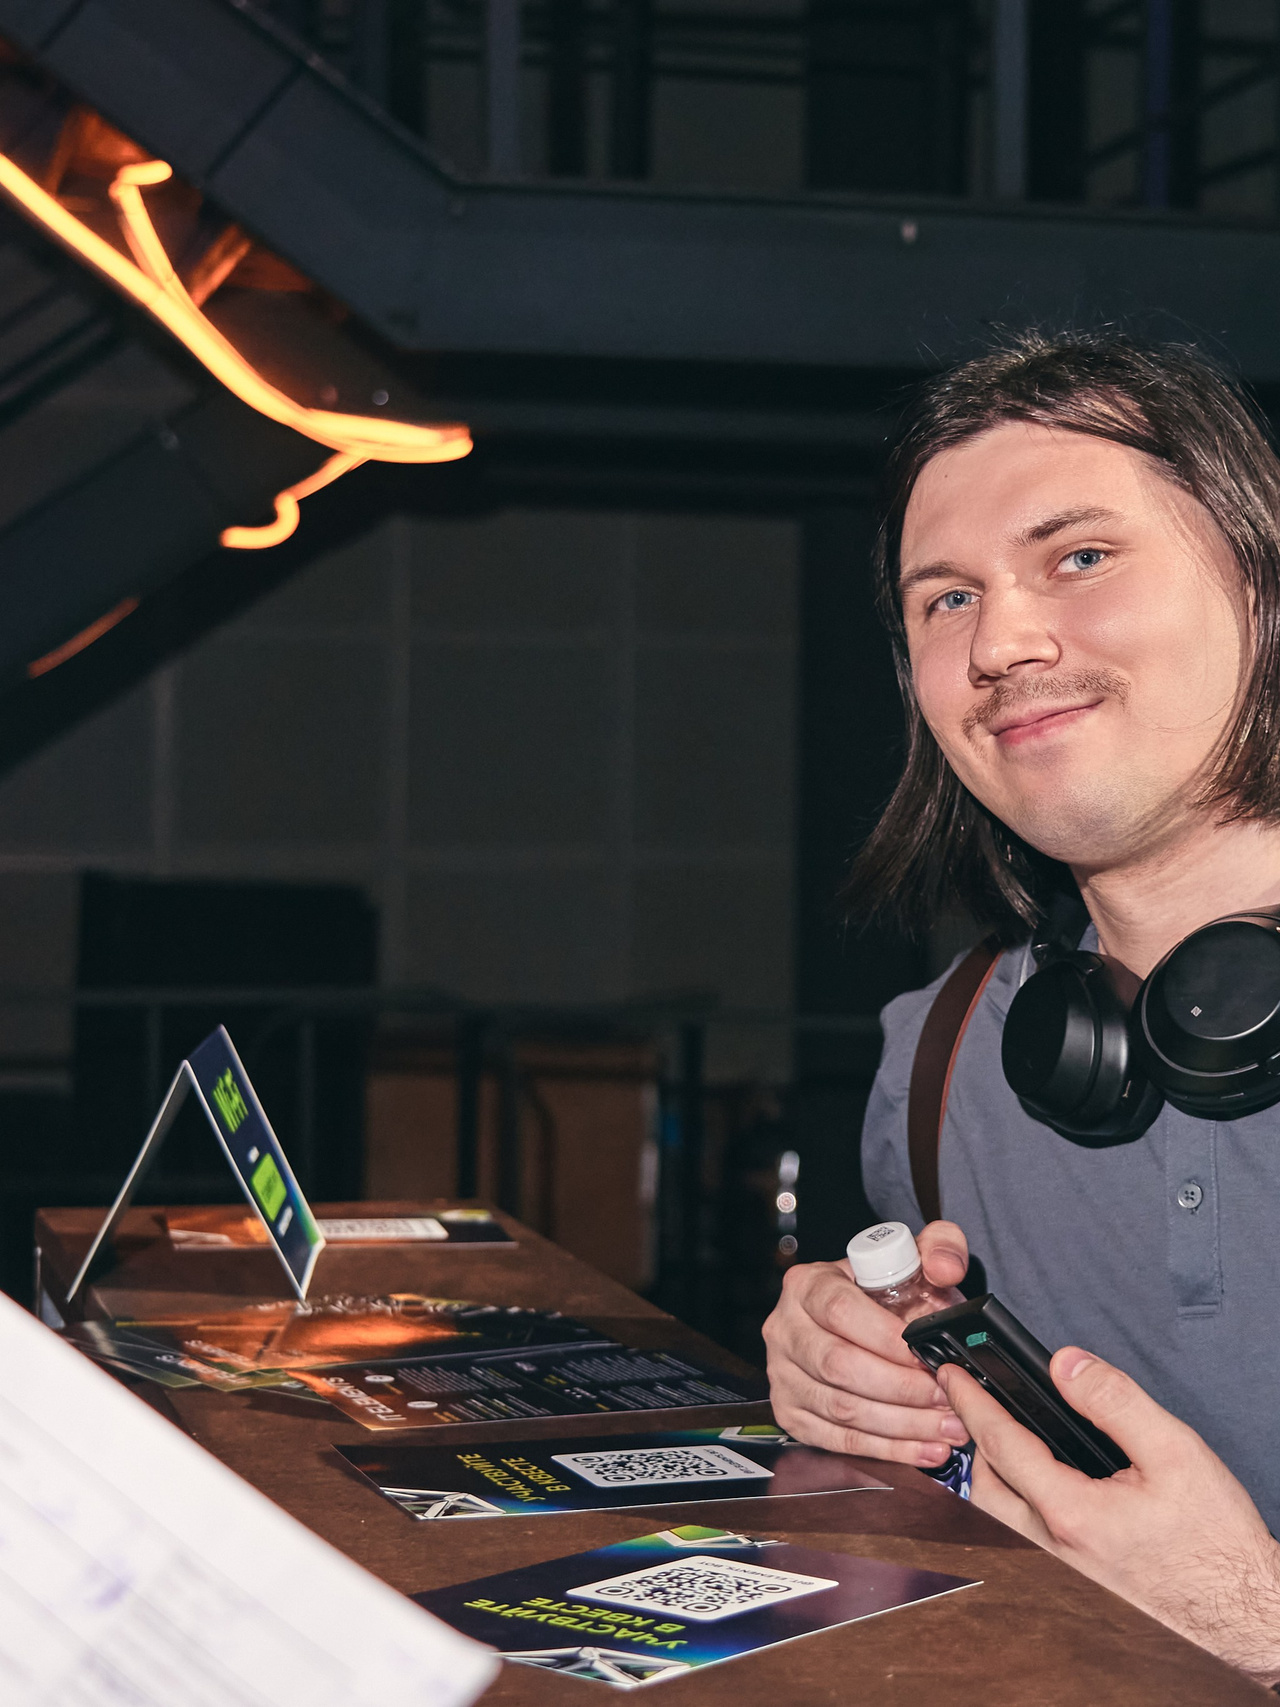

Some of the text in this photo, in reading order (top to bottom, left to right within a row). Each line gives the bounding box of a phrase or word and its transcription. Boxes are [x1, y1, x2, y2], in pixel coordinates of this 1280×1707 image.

[457, 1453, 546, 1502] УЧАСТВУЙТЕ
[500, 1456, 571, 1492] В КВЕСТЕ
[463, 1597, 688, 1649] УЧАСТВУЙТЕ
[523, 1597, 686, 1634] В КВЕСТЕ
